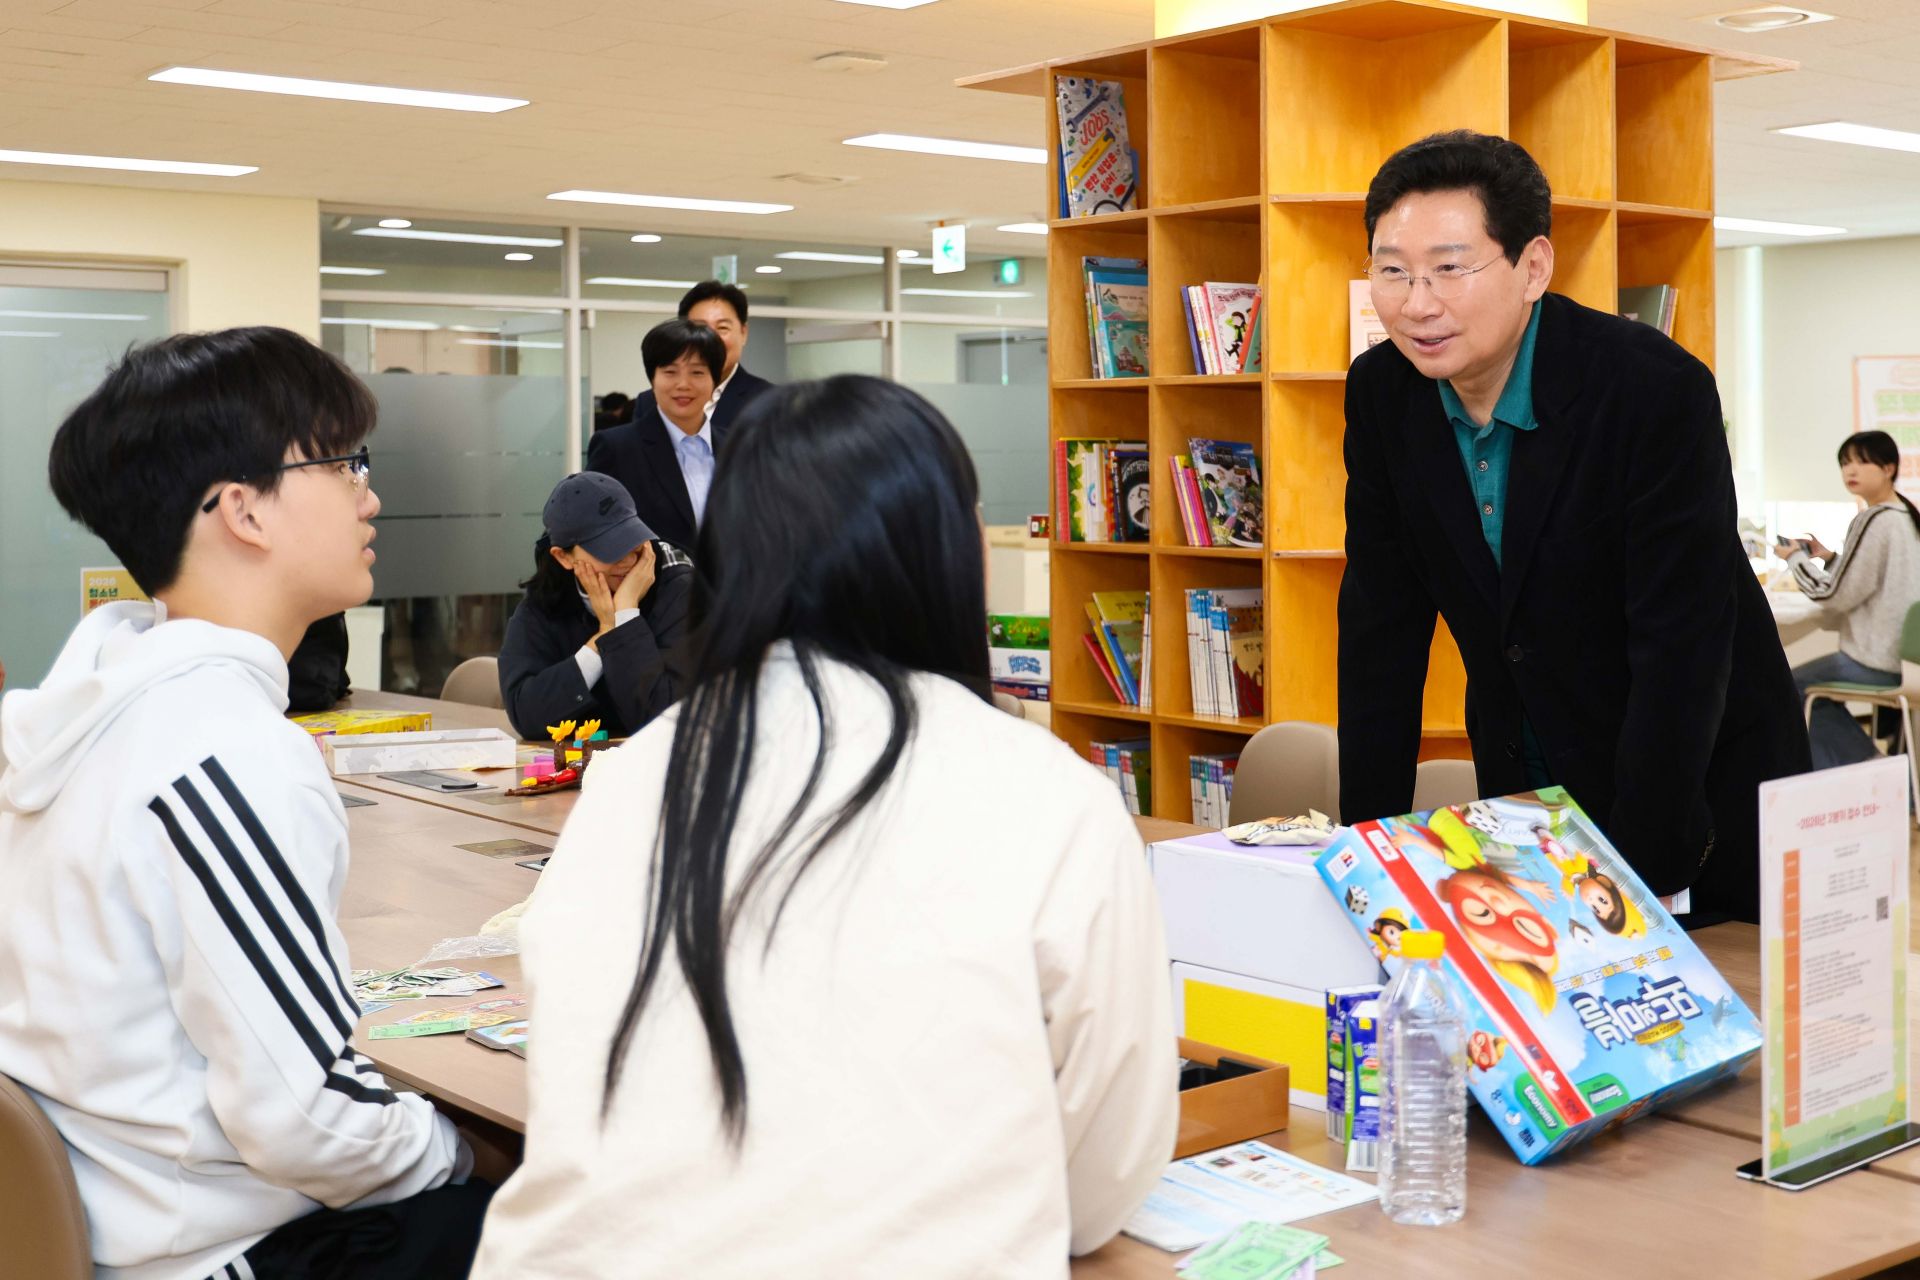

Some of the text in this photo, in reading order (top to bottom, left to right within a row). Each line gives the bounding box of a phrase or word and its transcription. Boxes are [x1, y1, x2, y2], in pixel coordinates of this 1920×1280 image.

[1098, 152, 1117, 173] 직업은
[89, 587, 118, 598] 청소년
[1568, 976, 1703, 1050] 모두의마블
[1523, 1084, 1559, 1129] Economy
